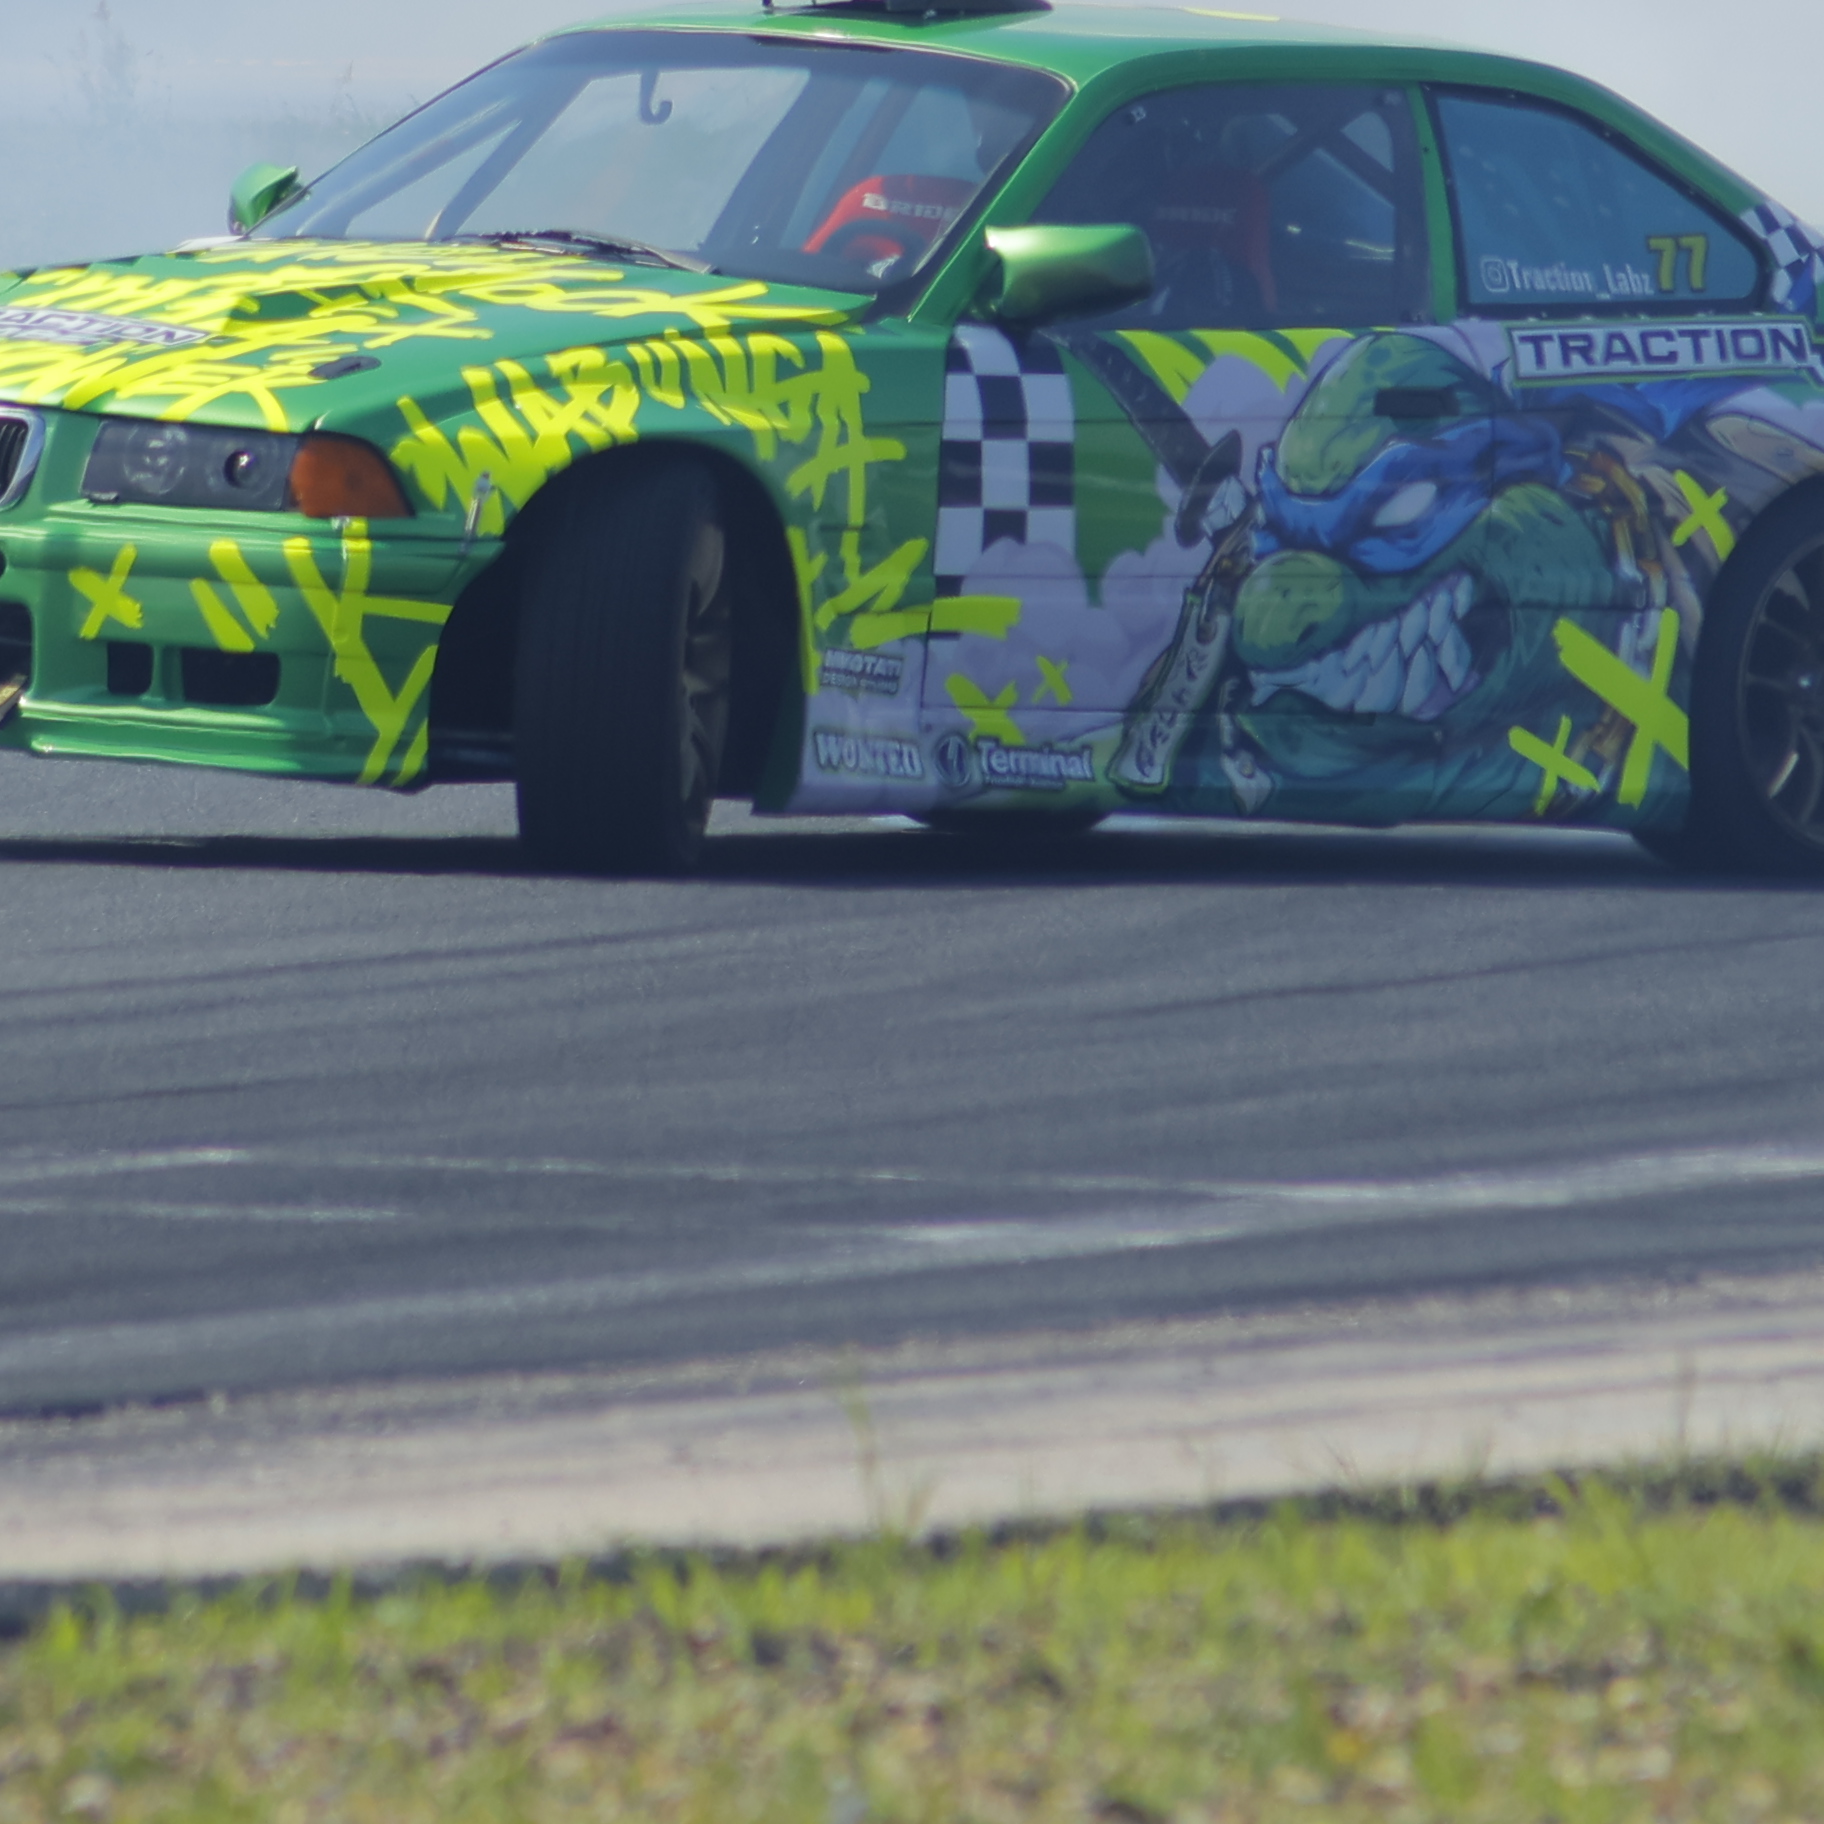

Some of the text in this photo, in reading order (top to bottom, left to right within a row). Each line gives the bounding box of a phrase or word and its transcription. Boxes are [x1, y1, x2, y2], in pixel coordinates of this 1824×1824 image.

[1647, 234, 1709, 293] 77
[1518, 327, 1810, 371] TRACTION
[976, 739, 1094, 779] Terminal
